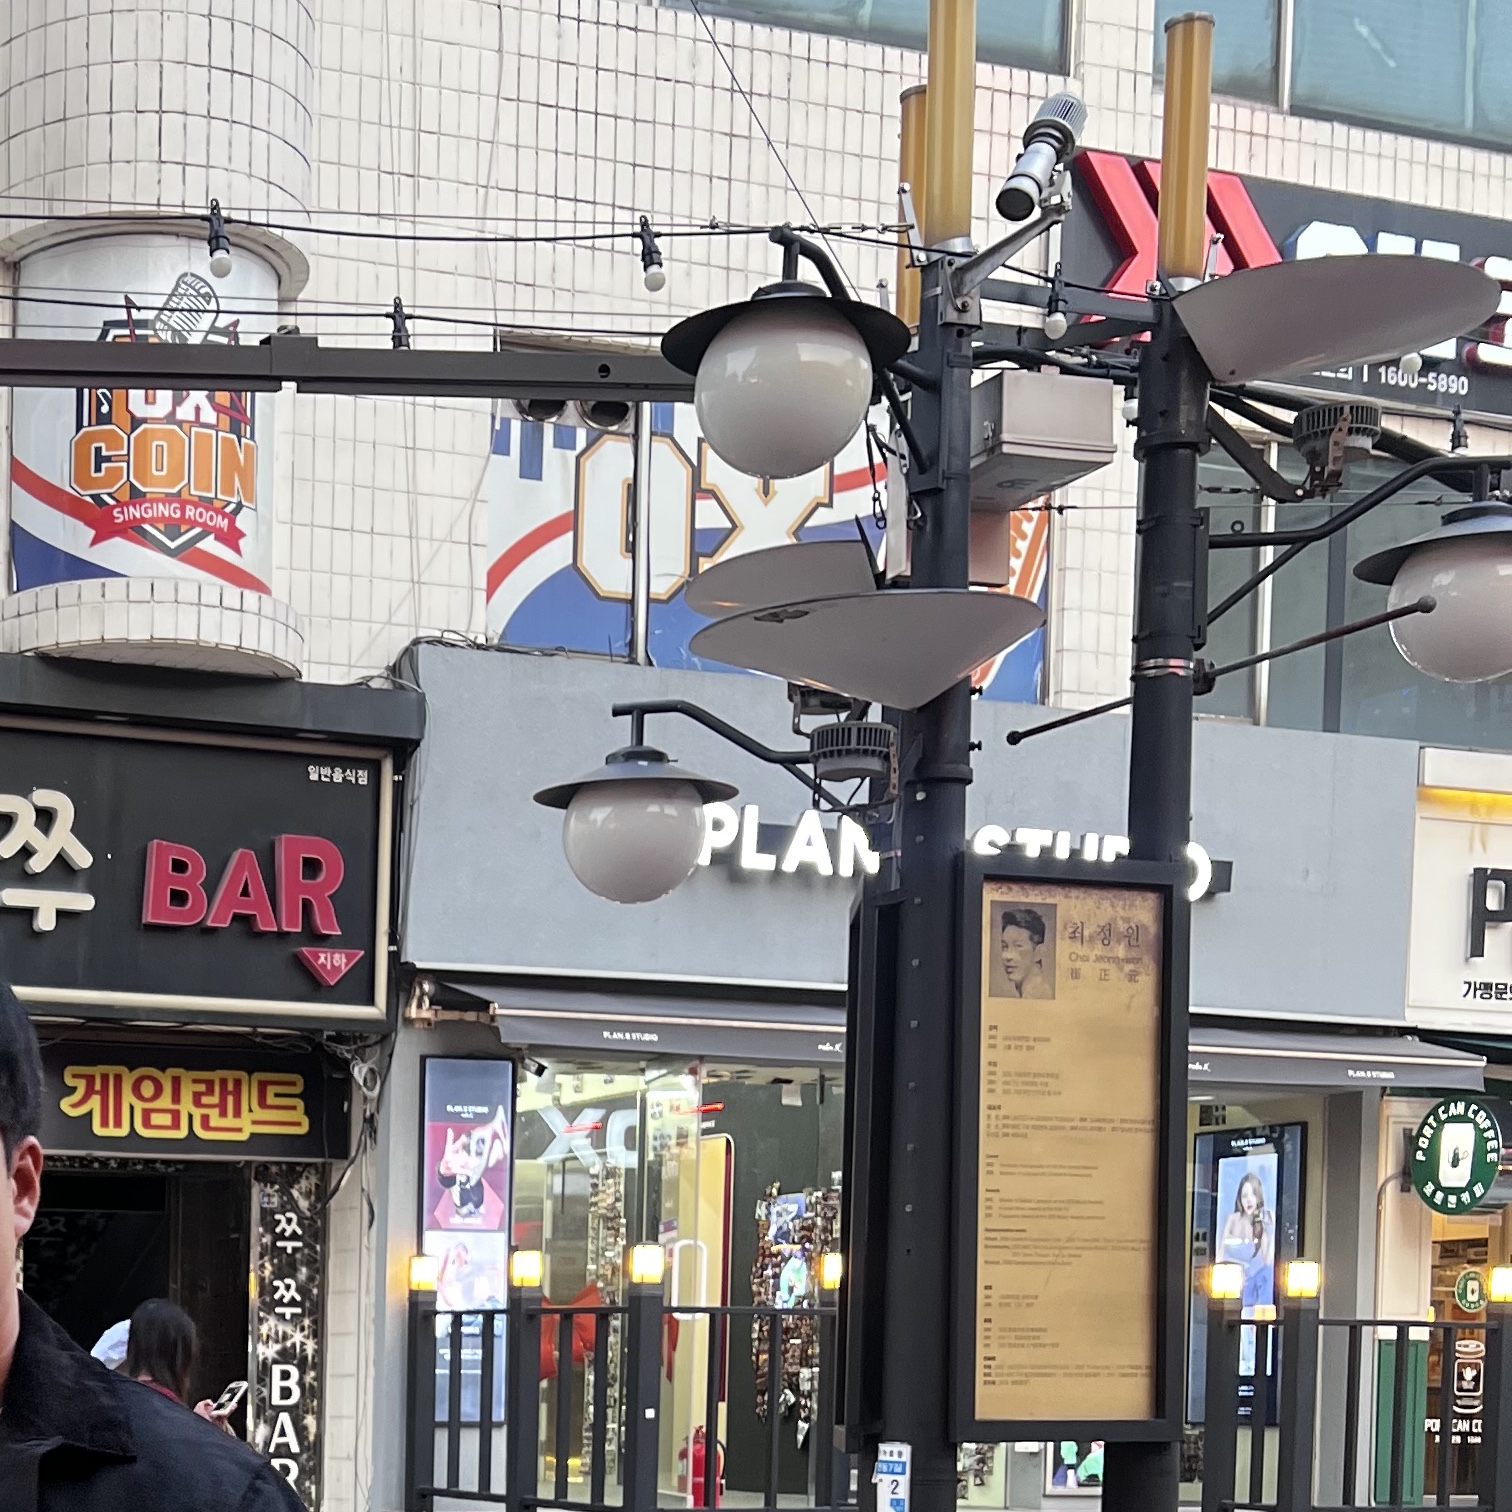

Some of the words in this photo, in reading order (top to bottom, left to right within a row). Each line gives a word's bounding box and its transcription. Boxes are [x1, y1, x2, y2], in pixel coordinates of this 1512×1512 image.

[69, 423, 258, 512] COIN
[112, 502, 181, 523] SINGING
[185, 504, 229, 532] ROOM
[307, 764, 369, 786] 일반음식점
[142, 833, 345, 936] BAR
[317, 950, 348, 971] 지하
[1462, 981, 1512, 1001] 가맹문
[59, 1065, 309, 1141] 게임랜드
[1415, 1115, 1437, 1162] PORT
[1437, 1101, 1465, 1120] CAN
[1468, 1103, 1499, 1163] COFFEE
[890, 1479, 899, 1495] 2
